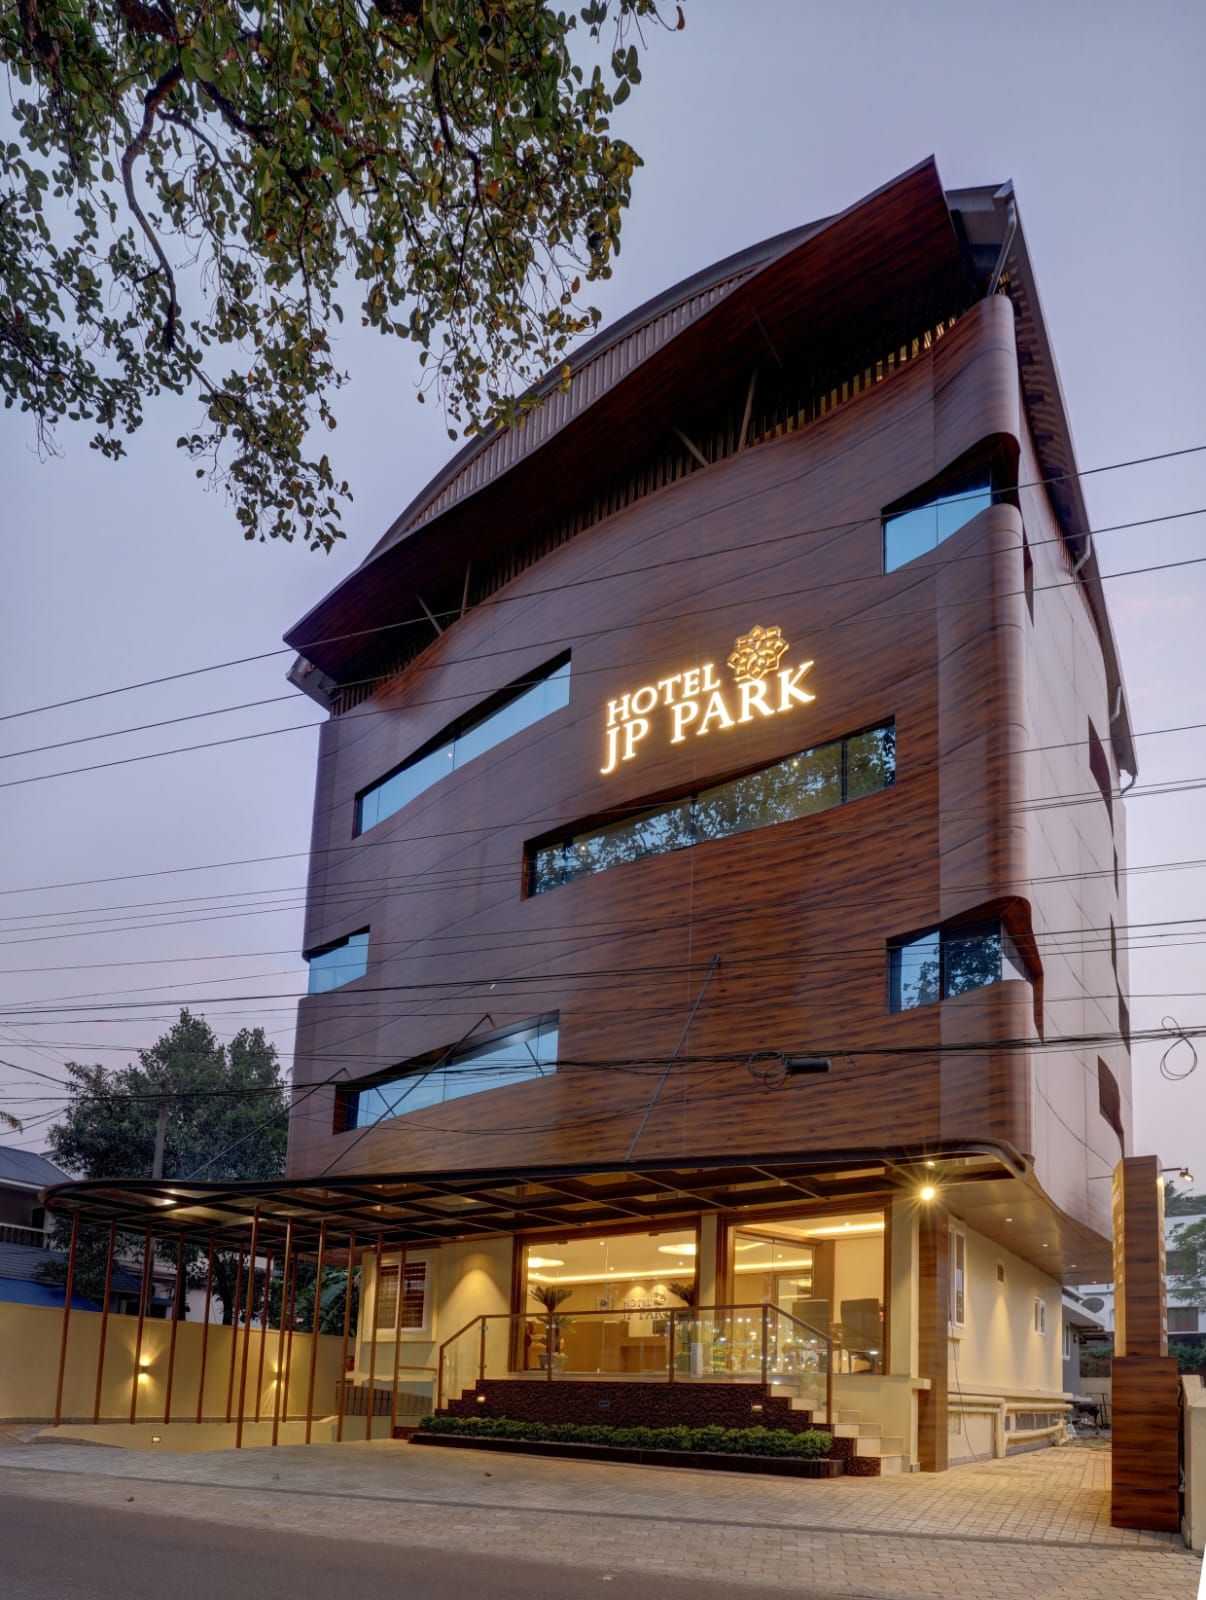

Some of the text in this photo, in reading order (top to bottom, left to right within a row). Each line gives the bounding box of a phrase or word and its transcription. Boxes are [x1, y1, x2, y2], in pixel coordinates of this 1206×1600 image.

[600, 660, 816, 774] JP PARK
[606, 663, 721, 727] HOTEL
